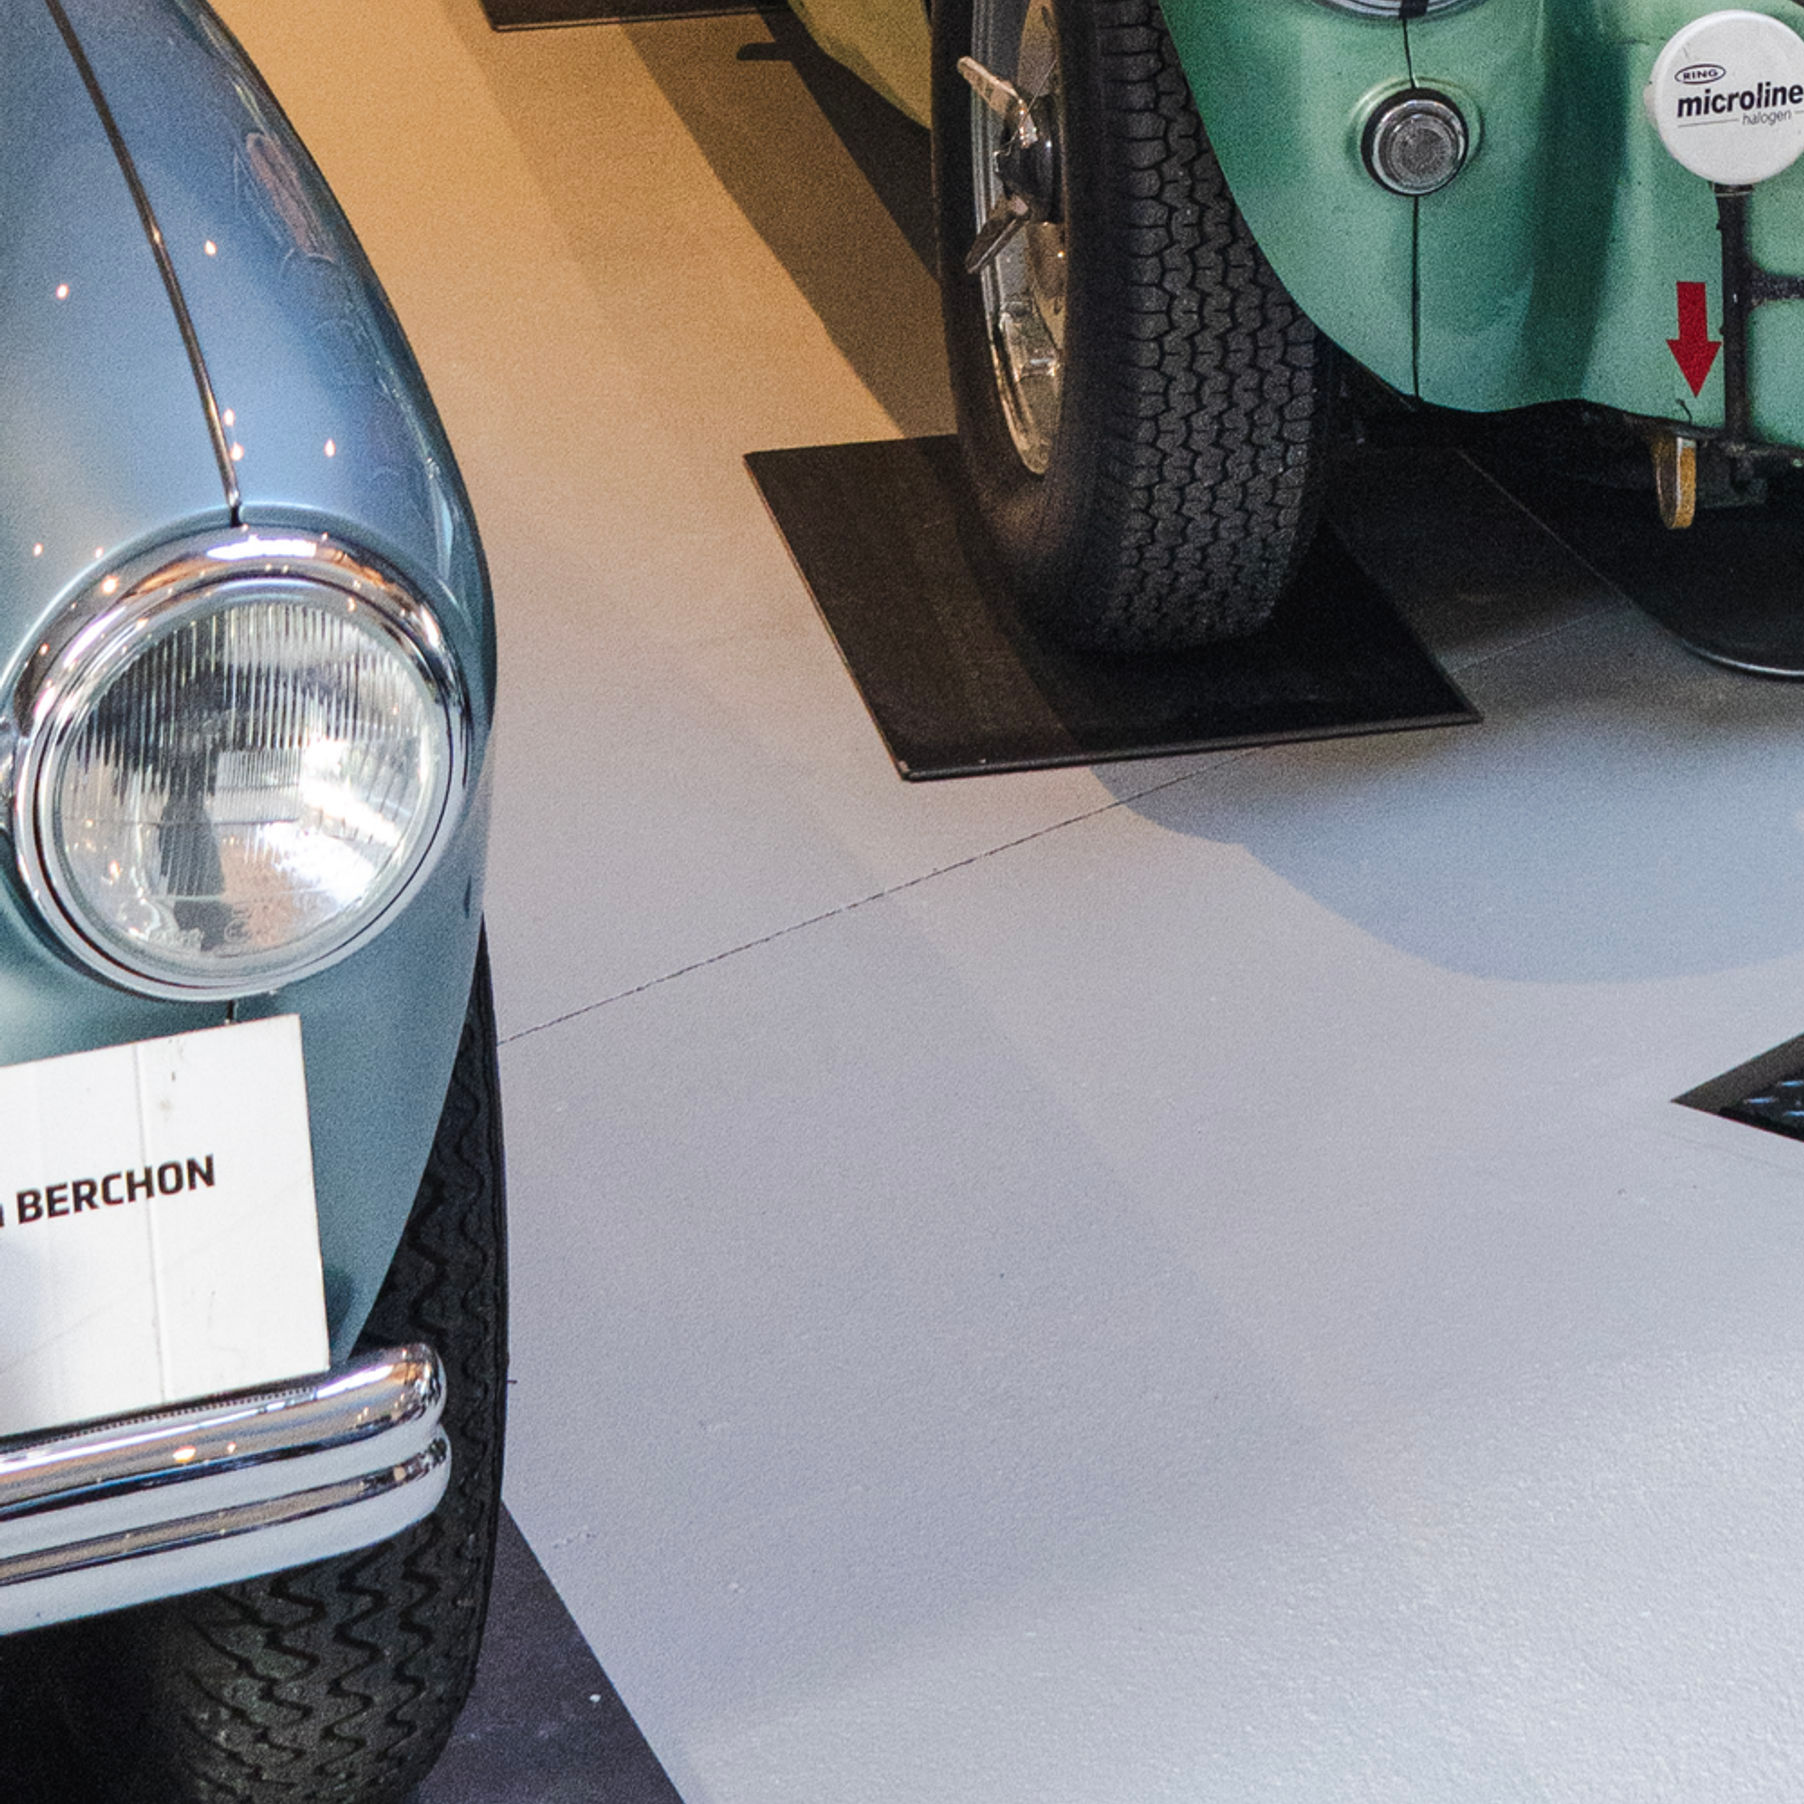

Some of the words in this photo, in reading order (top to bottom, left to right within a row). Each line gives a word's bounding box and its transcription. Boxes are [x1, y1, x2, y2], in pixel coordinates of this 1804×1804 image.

[1681, 68, 1719, 81] RING
[1676, 80, 1804, 118] microline
[1741, 109, 1793, 127] halogen
[16, 1153, 215, 1225] BERCHON
